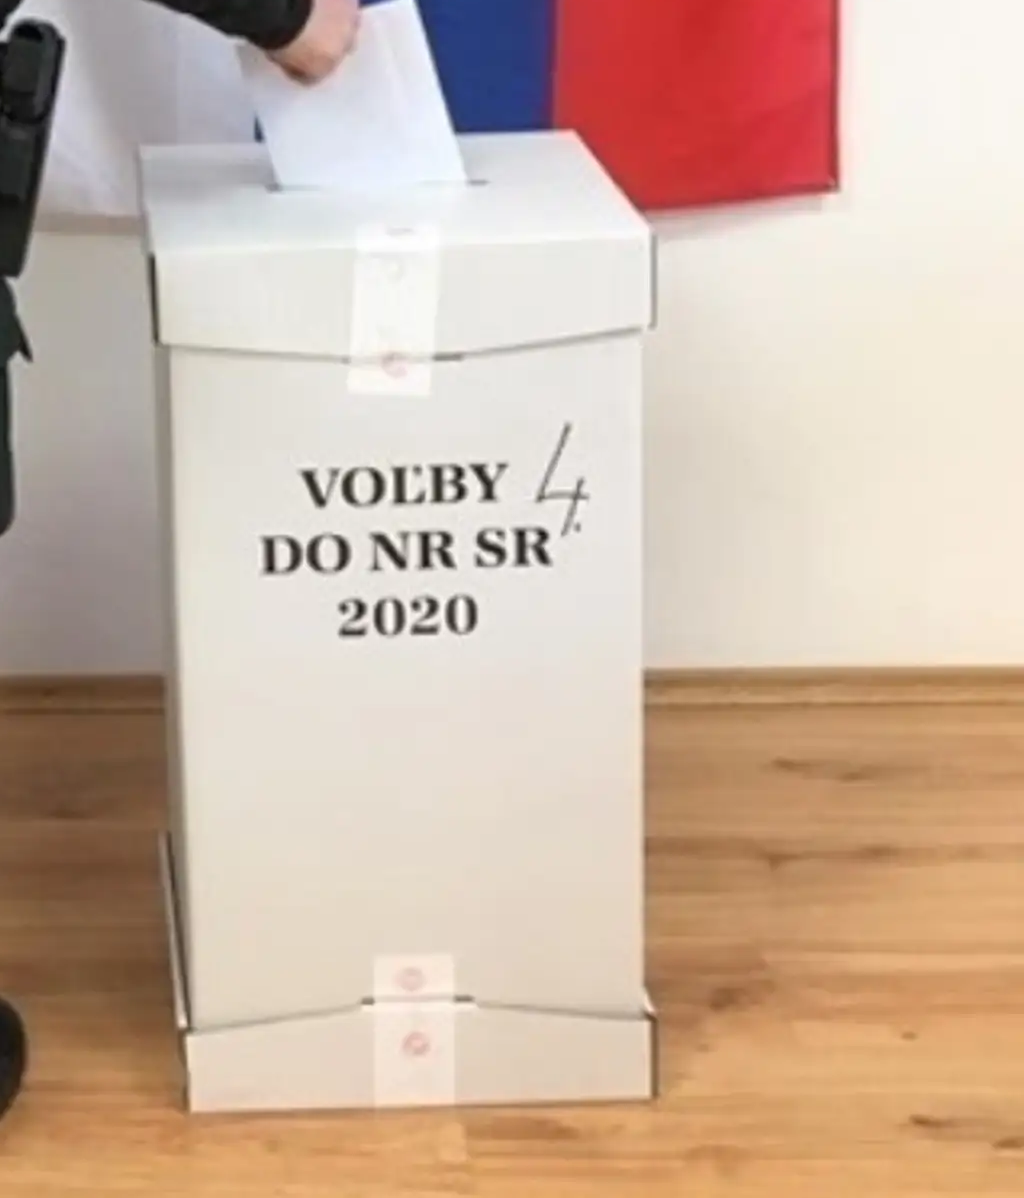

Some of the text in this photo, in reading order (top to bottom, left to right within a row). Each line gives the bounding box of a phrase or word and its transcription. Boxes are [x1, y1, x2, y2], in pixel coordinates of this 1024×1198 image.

[298, 462, 509, 509] VOĽBY
[259, 526, 553, 576] DO NR SR
[337, 594, 479, 638] 2020
